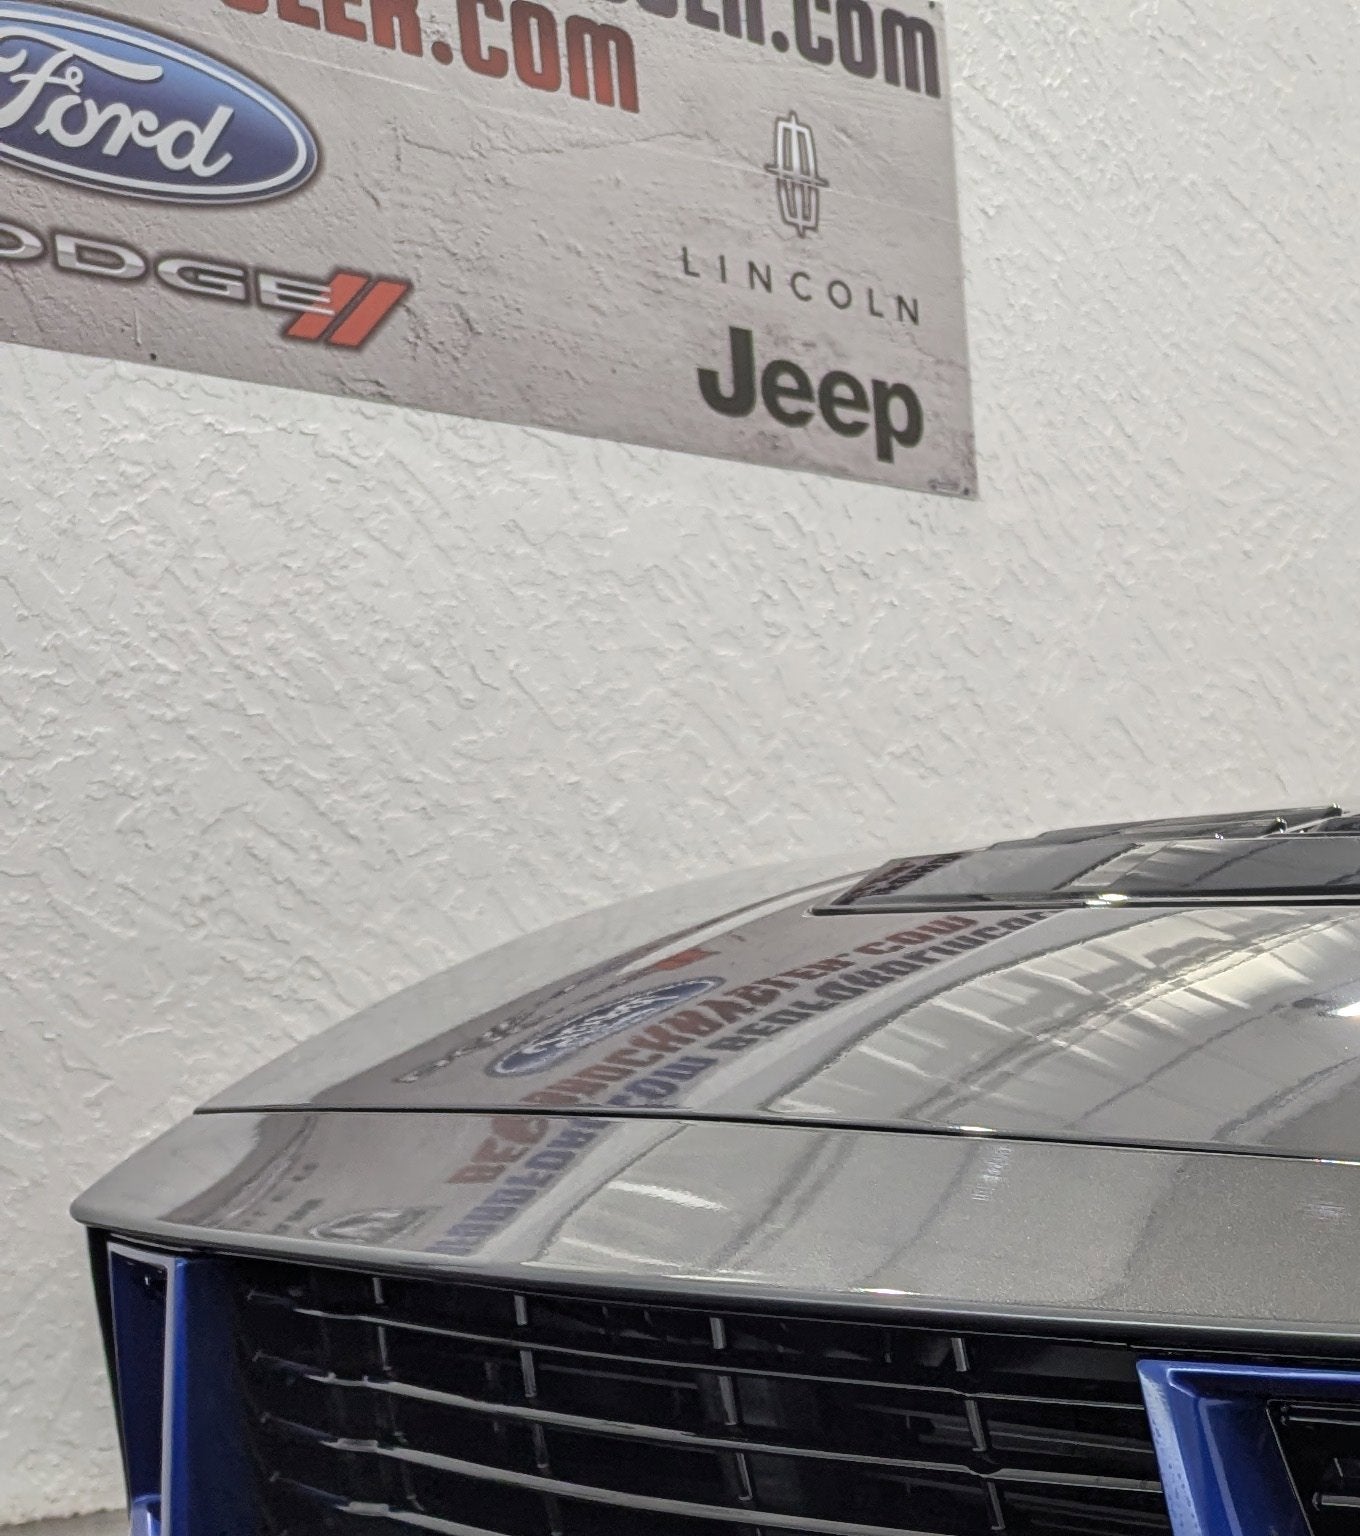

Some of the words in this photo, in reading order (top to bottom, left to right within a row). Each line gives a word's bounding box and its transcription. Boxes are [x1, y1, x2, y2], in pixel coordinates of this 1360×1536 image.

[0, 26, 234, 178] Ford
[682, 246, 920, 326] LINCOLN
[696, 325, 924, 464] Jeep
